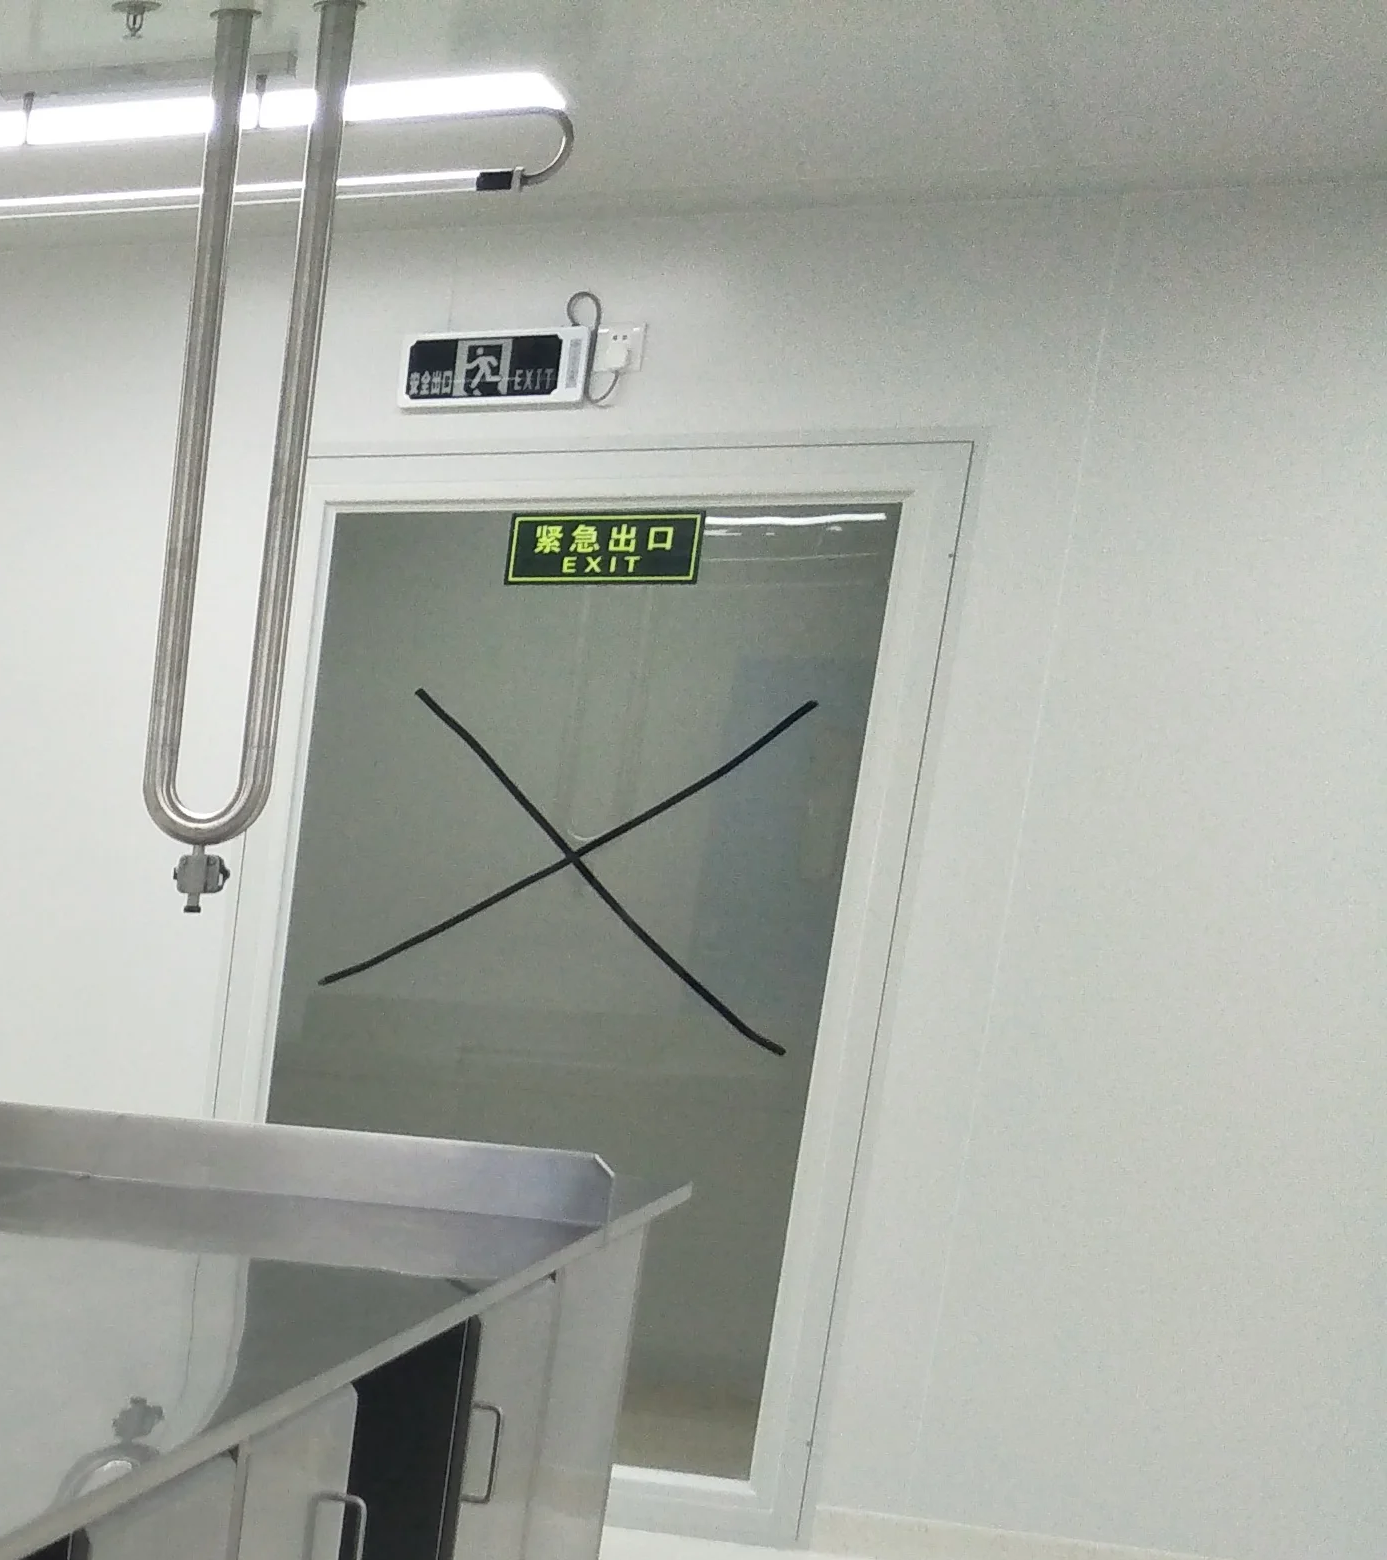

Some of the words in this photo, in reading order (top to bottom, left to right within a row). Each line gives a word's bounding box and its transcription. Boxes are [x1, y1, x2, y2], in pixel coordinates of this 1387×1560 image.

[409, 370, 453, 395] 安全出口
[513, 368, 554, 391] EXIT
[534, 524, 674, 554] 紧急出口
[562, 556, 642, 573] EXIT
